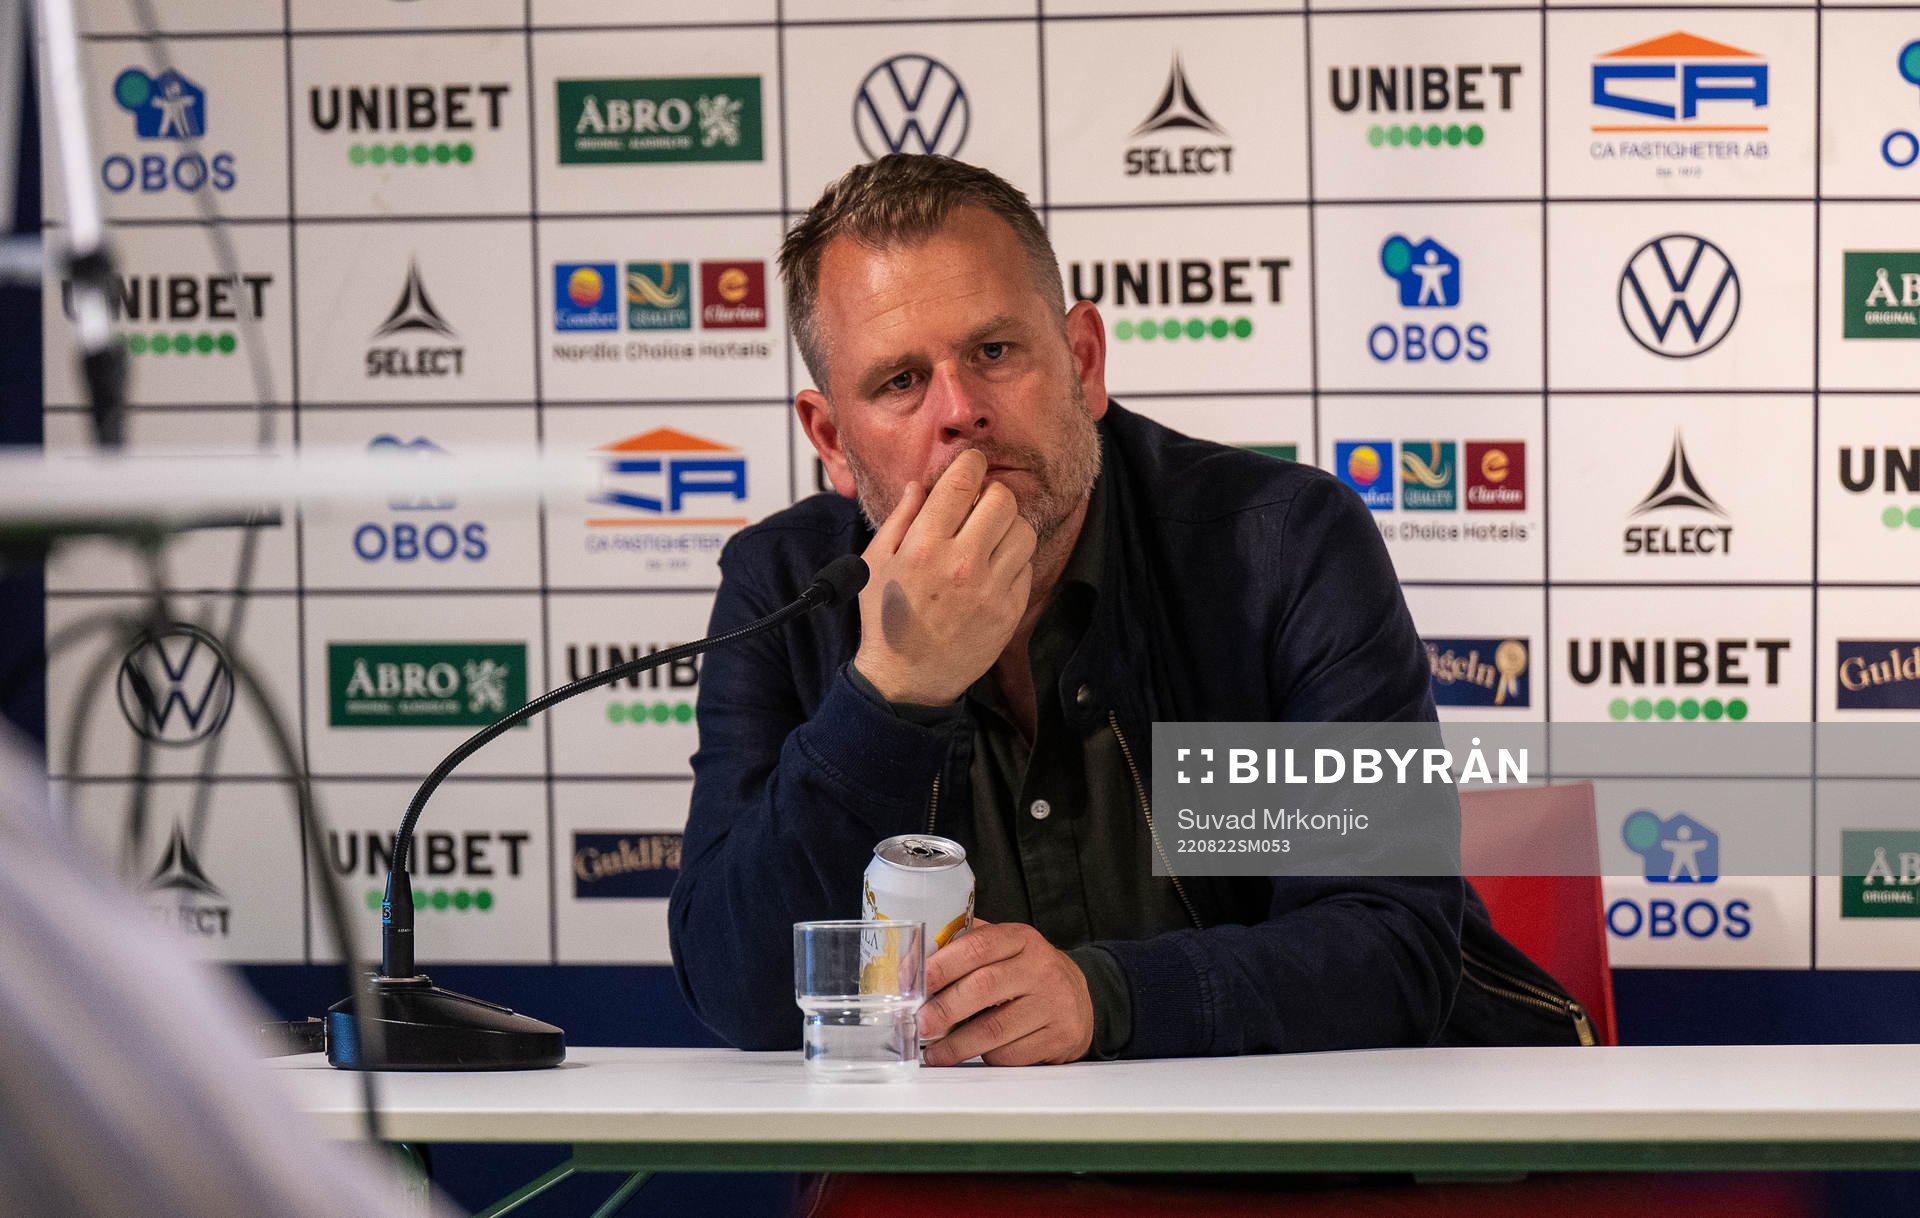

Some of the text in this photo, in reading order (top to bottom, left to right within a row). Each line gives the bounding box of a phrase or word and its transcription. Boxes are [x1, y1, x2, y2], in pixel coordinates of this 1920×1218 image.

[309, 84, 510, 132] UNIBET
[1329, 65, 1522, 113] UNIBET
[575, 95, 692, 134] ÅBRO
[1124, 146, 1234, 176] SELECT
[1589, 141, 1769, 160] CA FASTIGHETER AB
[101, 153, 237, 192] OBOS
[1070, 258, 1291, 305] UNIBET
[704, 303, 764, 324] Clarion
[365, 347, 465, 378] SELECT
[625, 344, 694, 361] Choice
[1367, 323, 1490, 363] OBOS
[1468, 485, 1522, 504] Clarion
[352, 522, 489, 563] OBOS
[1400, 521, 1458, 541] Choice
[1463, 521, 1528, 541] Hotels
[1624, 526, 1733, 555] SELECT
[346, 658, 461, 698] ÅBRO
[567, 643, 699, 688] UNIB
[1568, 638, 1791, 685] UNIBET
[1606, 899, 1752, 940] OBOS
